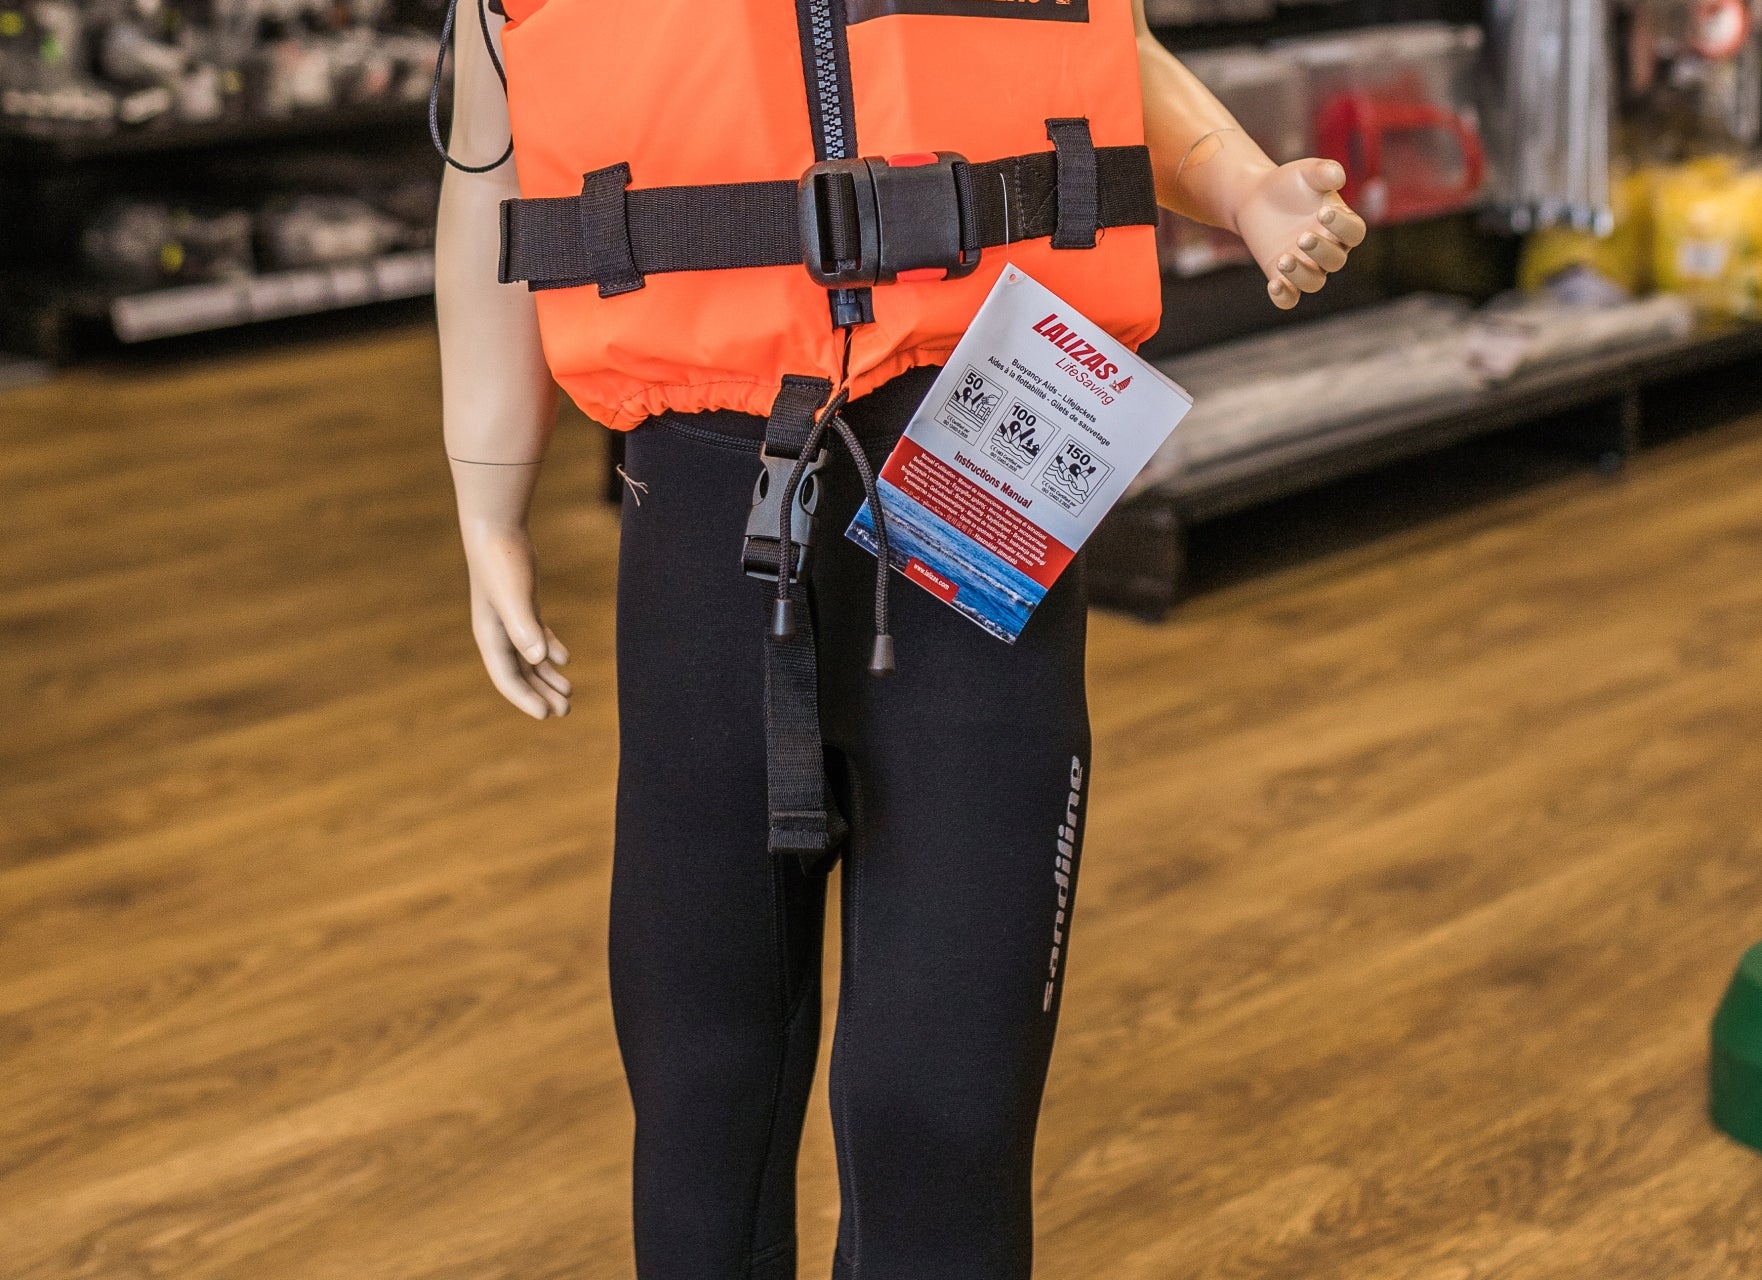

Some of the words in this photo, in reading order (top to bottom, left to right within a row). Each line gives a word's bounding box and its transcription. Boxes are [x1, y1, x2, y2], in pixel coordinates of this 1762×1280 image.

[1031, 312, 1118, 380] LALIZAS
[963, 370, 985, 391] 50
[987, 354, 1005, 371] Aides
[1008, 369, 1016, 378] la
[1049, 398, 1070, 417] Gilets
[1068, 411, 1079, 423] de
[1076, 419, 1111, 448] sauvetage
[1010, 357, 1043, 385] Buoyancy
[1041, 379, 1058, 395] Aids
[1061, 393, 1097, 423] Lifejackets
[1055, 357, 1114, 405] LifeSaving
[1008, 402, 1038, 428] 100
[953, 450, 1001, 488] Instructions
[999, 481, 1032, 509] Manual
[1063, 441, 1092, 467] 150
[1043, 755, 1082, 1012] sandiline
